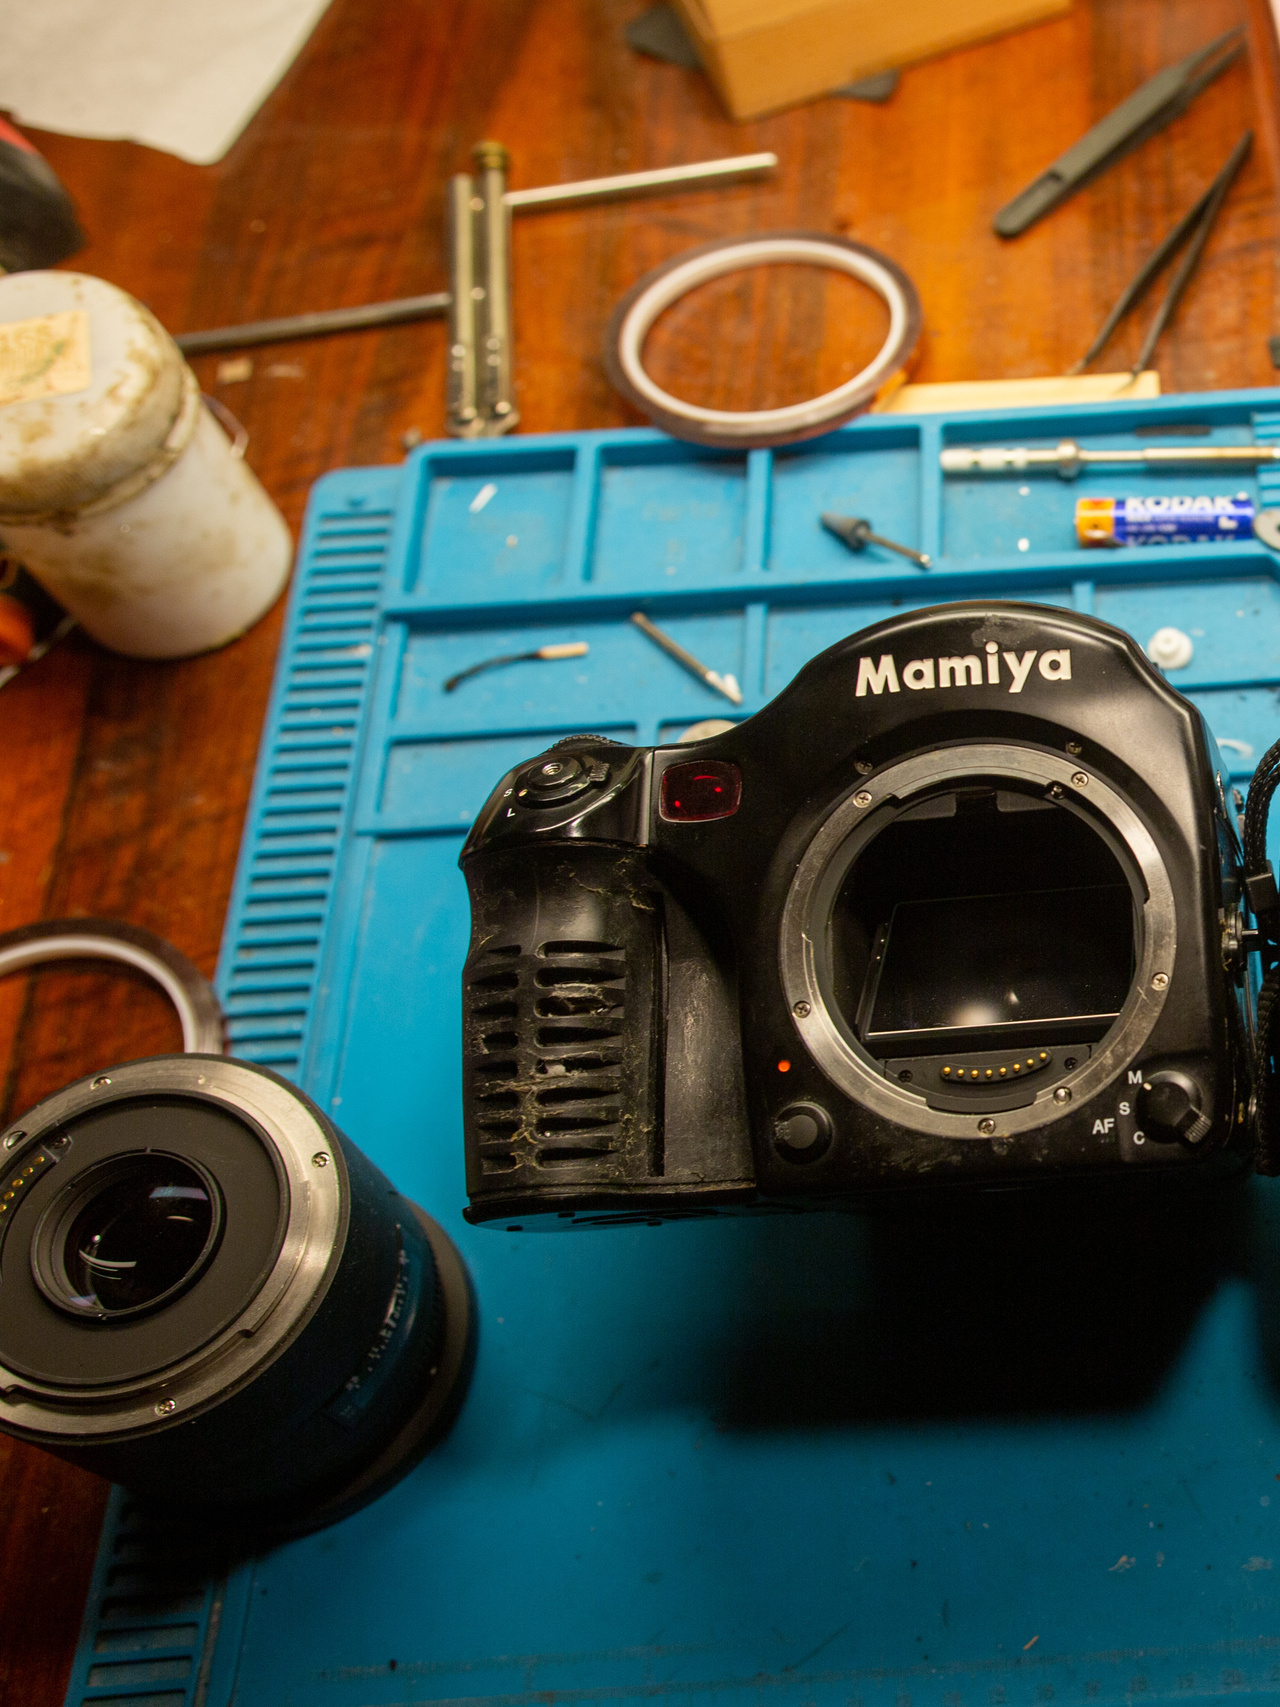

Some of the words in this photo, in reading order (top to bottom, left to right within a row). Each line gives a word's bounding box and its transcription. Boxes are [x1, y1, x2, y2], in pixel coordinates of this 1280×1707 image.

[1125, 496, 1236, 514] KODAK
[855, 641, 1072, 697] Mamiya
[503, 788, 513, 797] S
[506, 807, 516, 818] L
[1128, 1070, 1142, 1085] M
[1119, 1102, 1131, 1116] S
[1092, 1118, 1115, 1135] AF
[1133, 1131, 1146, 1145] C
